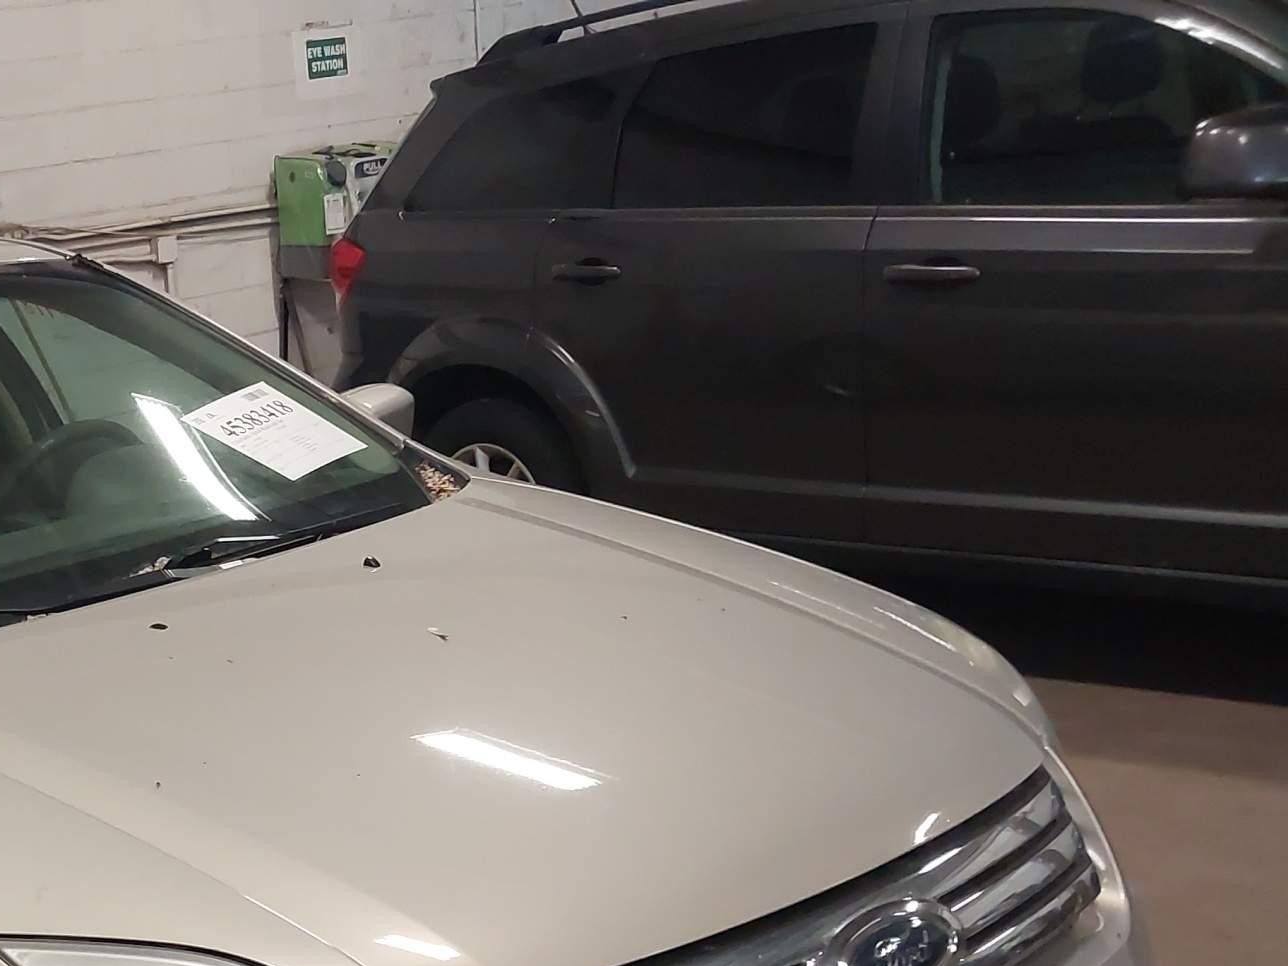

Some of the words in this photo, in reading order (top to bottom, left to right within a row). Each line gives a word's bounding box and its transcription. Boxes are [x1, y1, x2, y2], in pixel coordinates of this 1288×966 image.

[307, 46, 323, 59] EYE
[323, 44, 346, 57] WASH
[311, 58, 344, 72] STATION
[220, 400, 295, 437] 45383418
